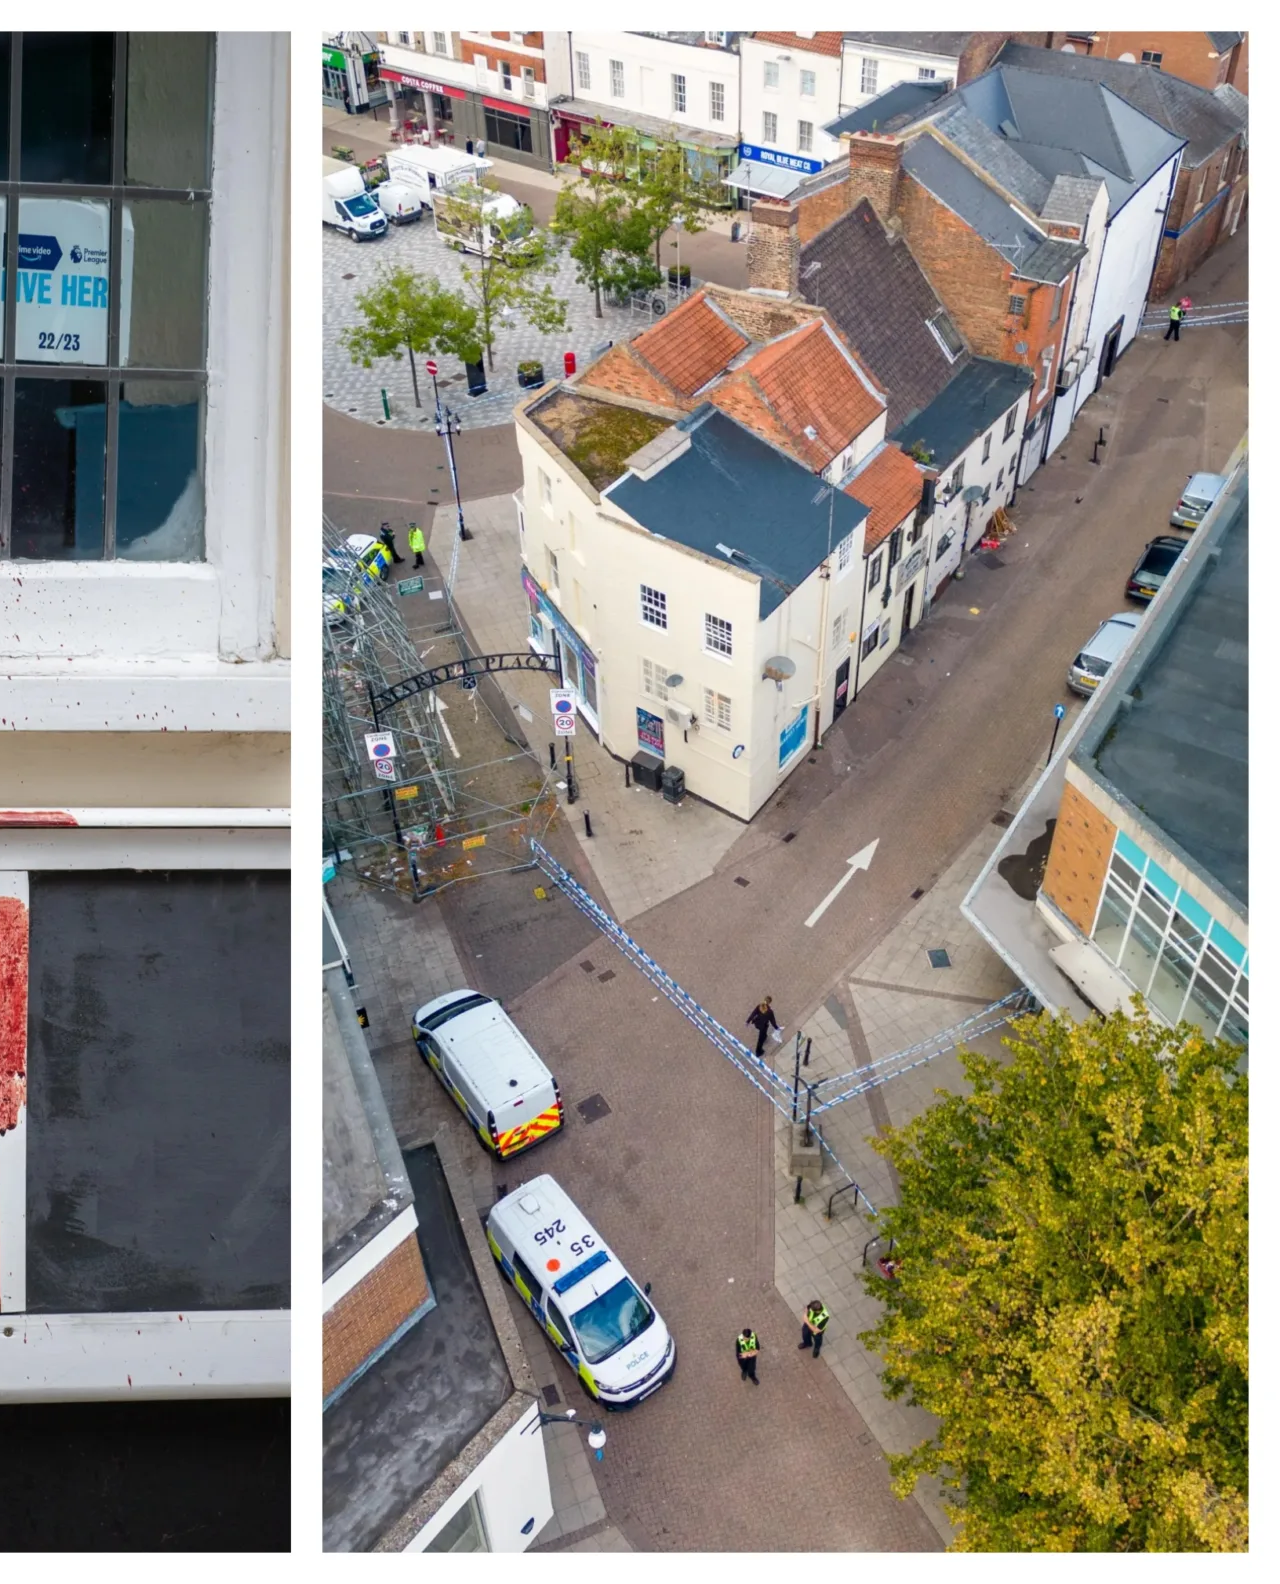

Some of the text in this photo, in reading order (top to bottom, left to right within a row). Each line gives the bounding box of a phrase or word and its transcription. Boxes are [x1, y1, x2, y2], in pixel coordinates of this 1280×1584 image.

[401, 75, 444, 93] COSTA COFFEE
[760, 150, 775, 163] ROYAL
[776, 153, 789, 165] BLUE
[789, 157, 803, 168] MEAT
[32, 245, 52, 256] video
[83, 247, 108, 257] Premier
[83, 256, 108, 265] League
[61, 274, 108, 308] HER
[38, 332, 81, 351] 22/23
[377, 654, 552, 704] MARKET PLACE
[378, 762, 390, 771] 20
[533, 1218, 567, 1246] 245
[570, 1234, 596, 1257] 35
[626, 1351, 650, 1371] POLICE
